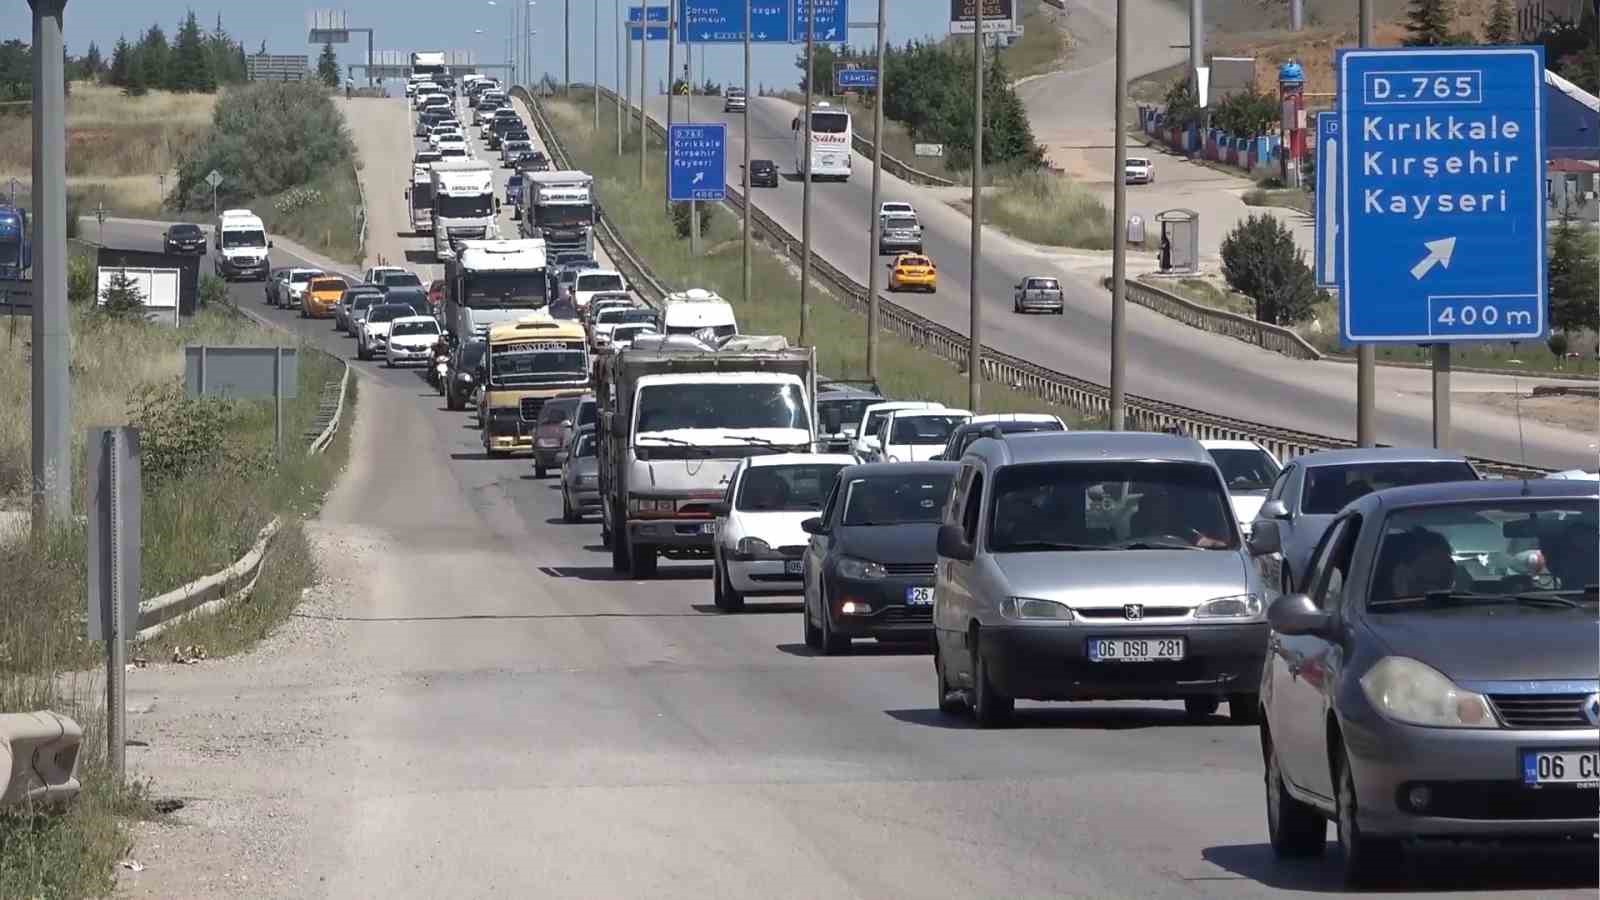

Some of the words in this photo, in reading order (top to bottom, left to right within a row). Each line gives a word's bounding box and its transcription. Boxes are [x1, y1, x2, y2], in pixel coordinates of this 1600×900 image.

[1363, 116, 1520, 142] Kırıkkale
[1363, 150, 1519, 178] Kırşehir
[1363, 189, 1507, 219] Kayseri
[1438, 305, 1499, 326] 400
[1506, 310, 1531, 325] m
[914, 588, 929, 601] 26
[1100, 641, 1115, 656] 06
[1123, 641, 1148, 656] DSD
[1158, 640, 1181, 656] 281
[1539, 755, 1564, 778] 06
